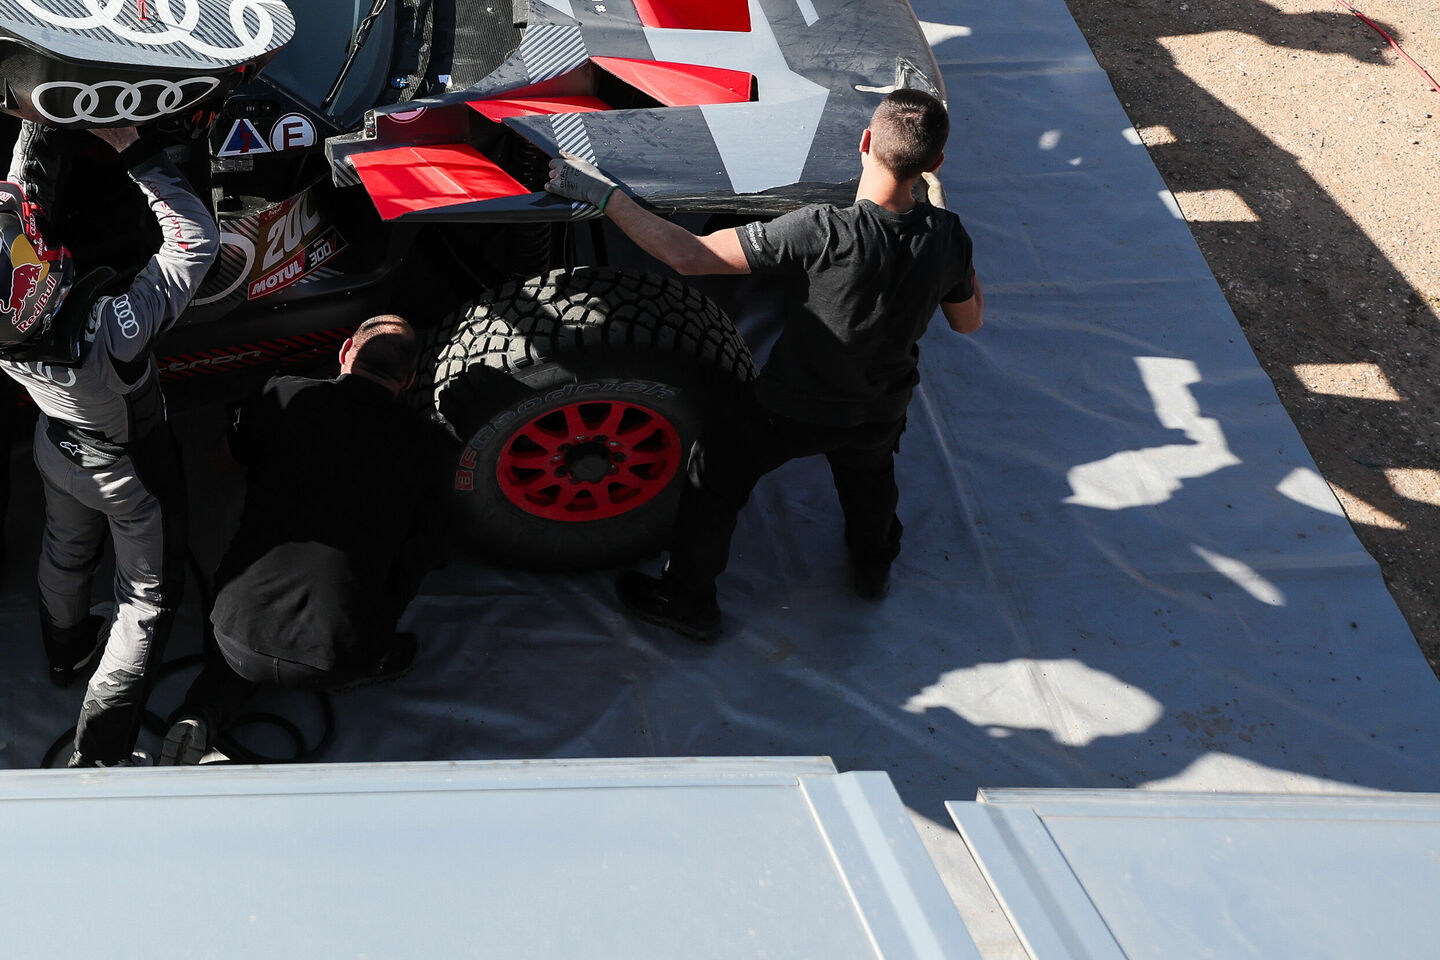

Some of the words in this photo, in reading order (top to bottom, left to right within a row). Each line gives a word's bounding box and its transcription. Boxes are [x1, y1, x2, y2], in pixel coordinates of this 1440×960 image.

[308, 233, 338, 268] 300V
[251, 259, 303, 296] MOTUL
[159, 350, 262, 372] -tron
[455, 382, 677, 490] BFGoodrich
